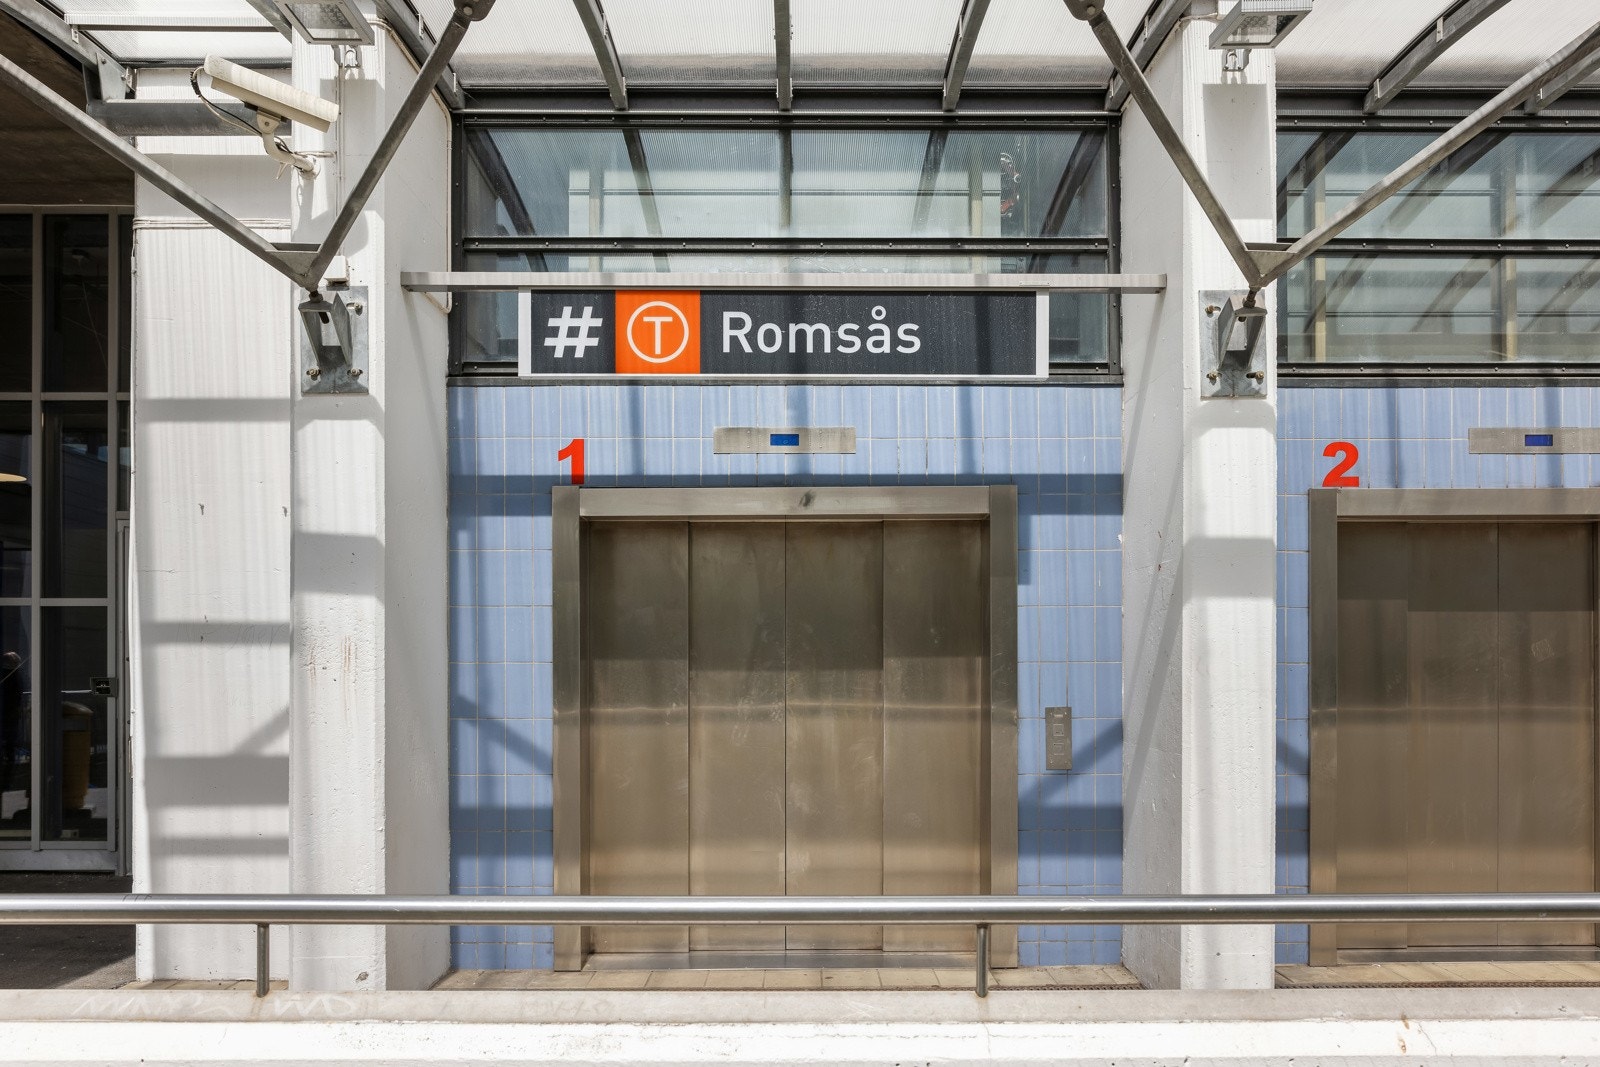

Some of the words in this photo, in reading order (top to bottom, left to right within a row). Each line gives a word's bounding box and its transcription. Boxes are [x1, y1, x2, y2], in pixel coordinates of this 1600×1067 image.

[722, 305, 922, 354] Romsås
[557, 438, 585, 485] 1
[1321, 441, 1360, 488] 2
